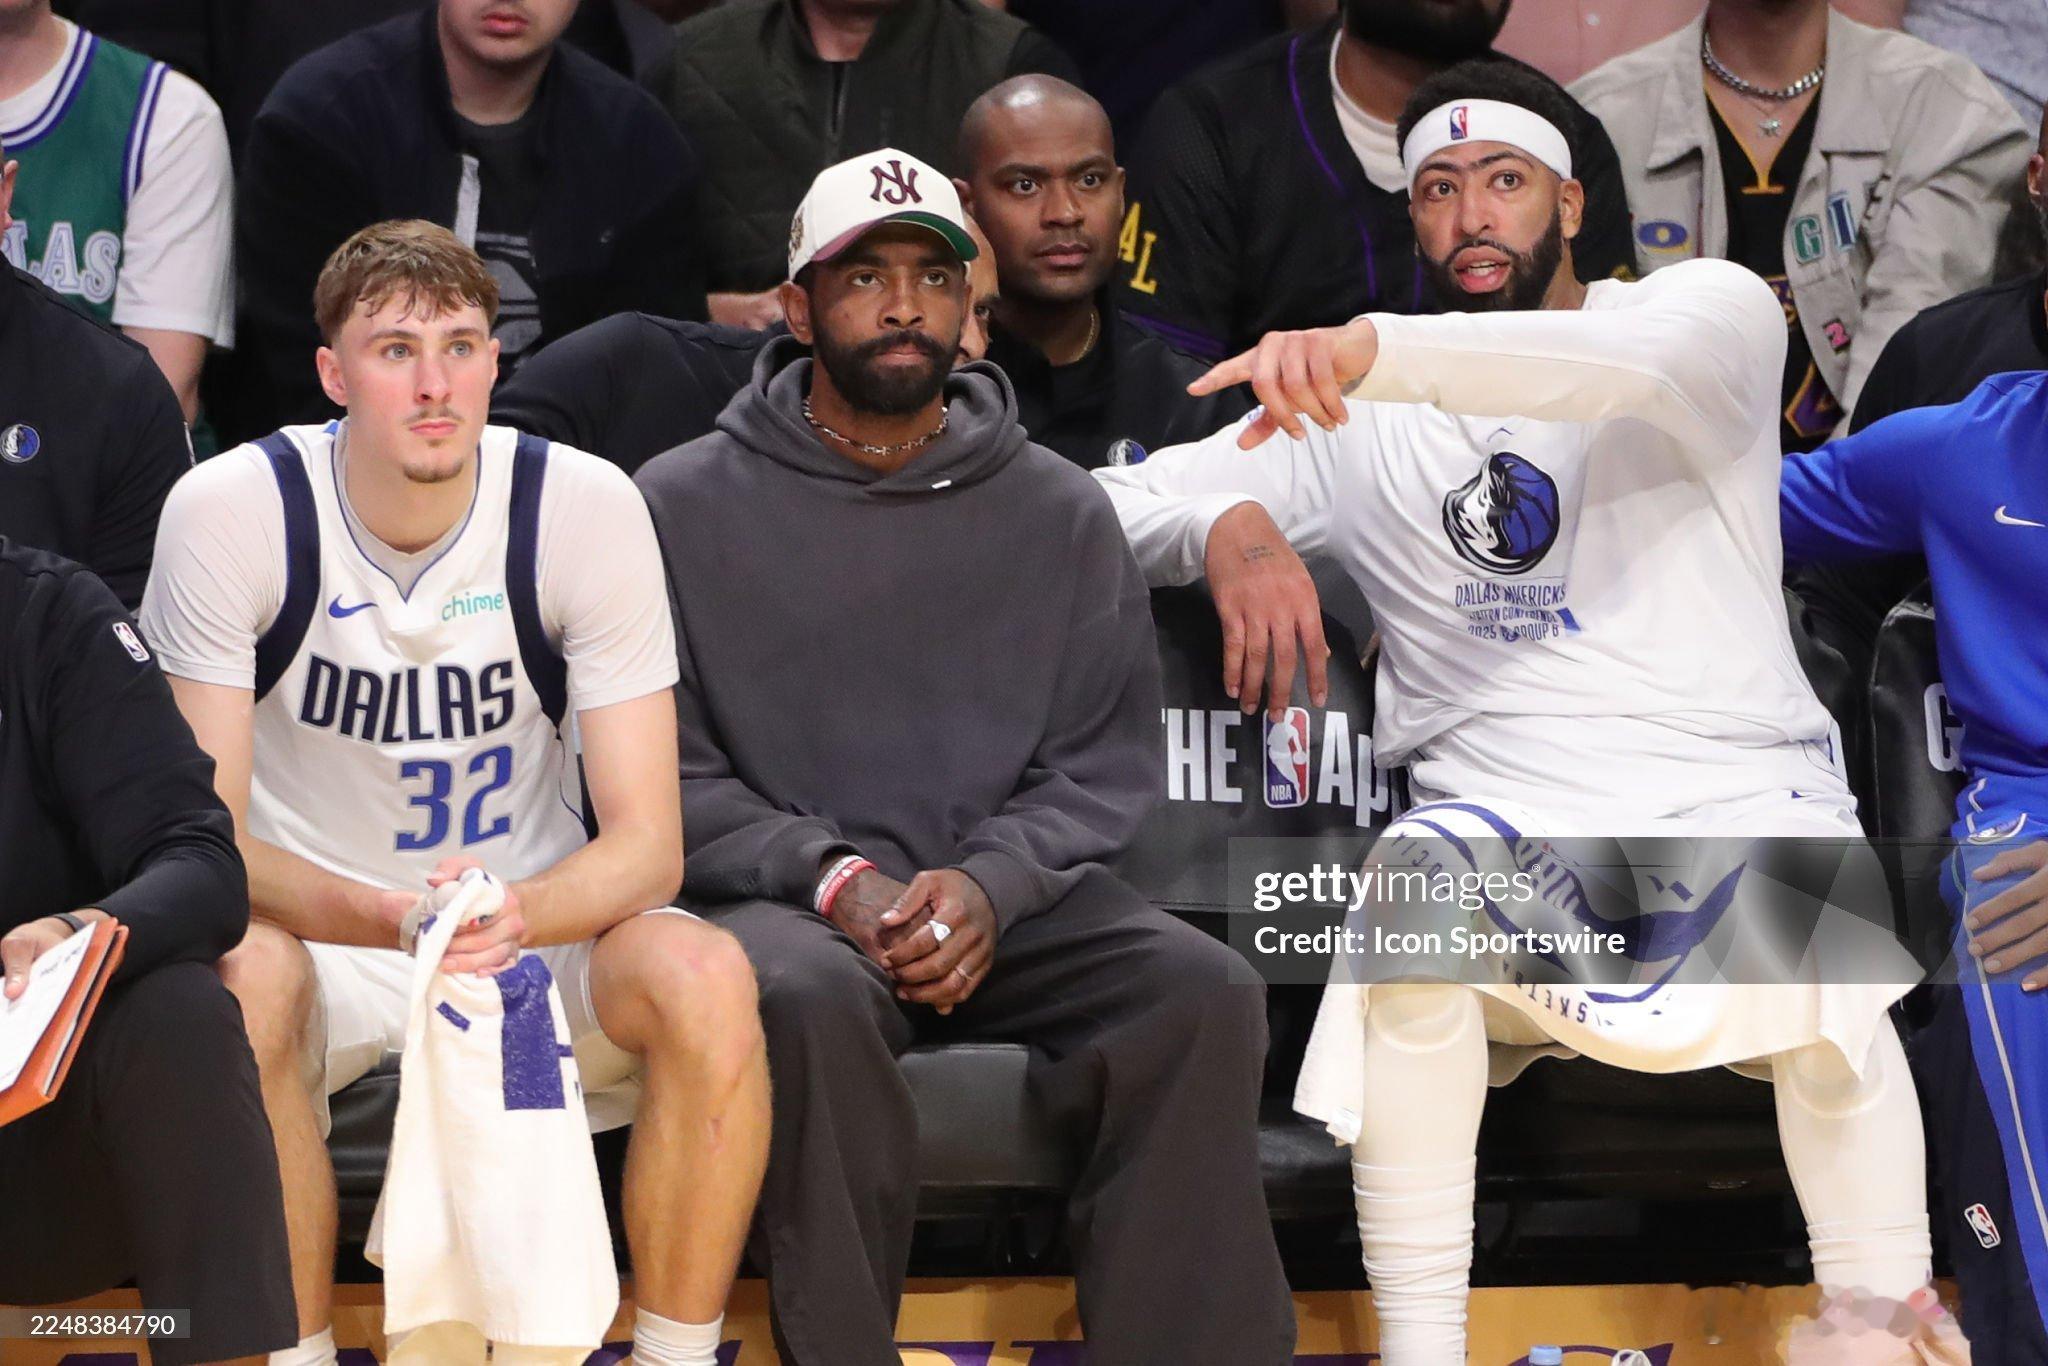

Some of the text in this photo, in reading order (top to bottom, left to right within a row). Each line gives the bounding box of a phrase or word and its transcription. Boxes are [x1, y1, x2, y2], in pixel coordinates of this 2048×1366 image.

[441, 591, 504, 621] chime
[1455, 582, 1500, 607] DALLAS
[299, 652, 516, 745] DALLAS
[394, 743, 513, 853] 32
[1161, 708, 1243, 803] HE
[1271, 784, 1292, 801] NBA
